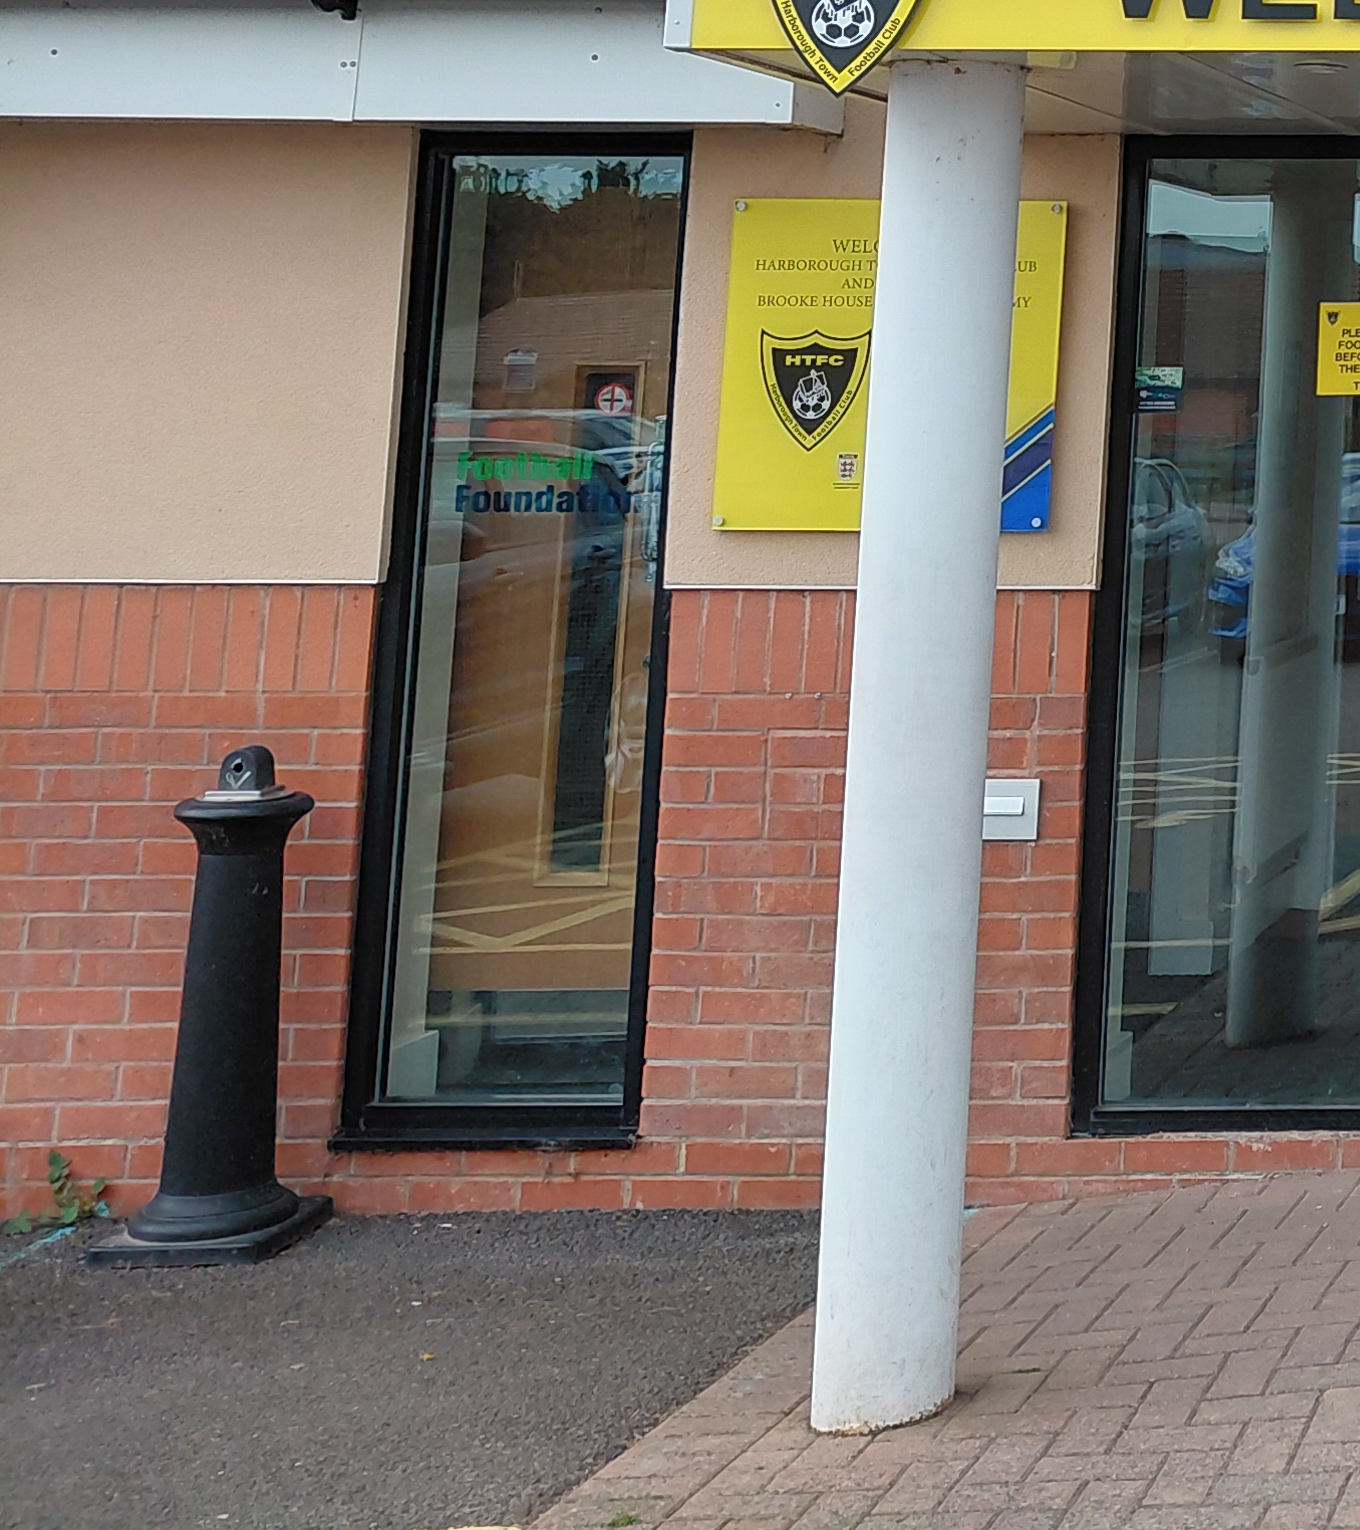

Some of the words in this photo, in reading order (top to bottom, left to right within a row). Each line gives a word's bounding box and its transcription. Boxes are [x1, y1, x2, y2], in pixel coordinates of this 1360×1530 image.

[780, 0, 817, 60] Harborough
[811, 55, 839, 84] Town
[847, 39, 886, 77] Football
[881, 16, 902, 41] Club
[755, 259, 862, 271] HARBOROUGH
[841, 278, 875, 289] AND
[757, 295, 819, 307] BROOKE
[822, 295, 874, 307] HOUSE
[785, 355, 845, 367] HTFC
[1338, 364, 1360, 374] THE
[456, 451, 595, 481] Football
